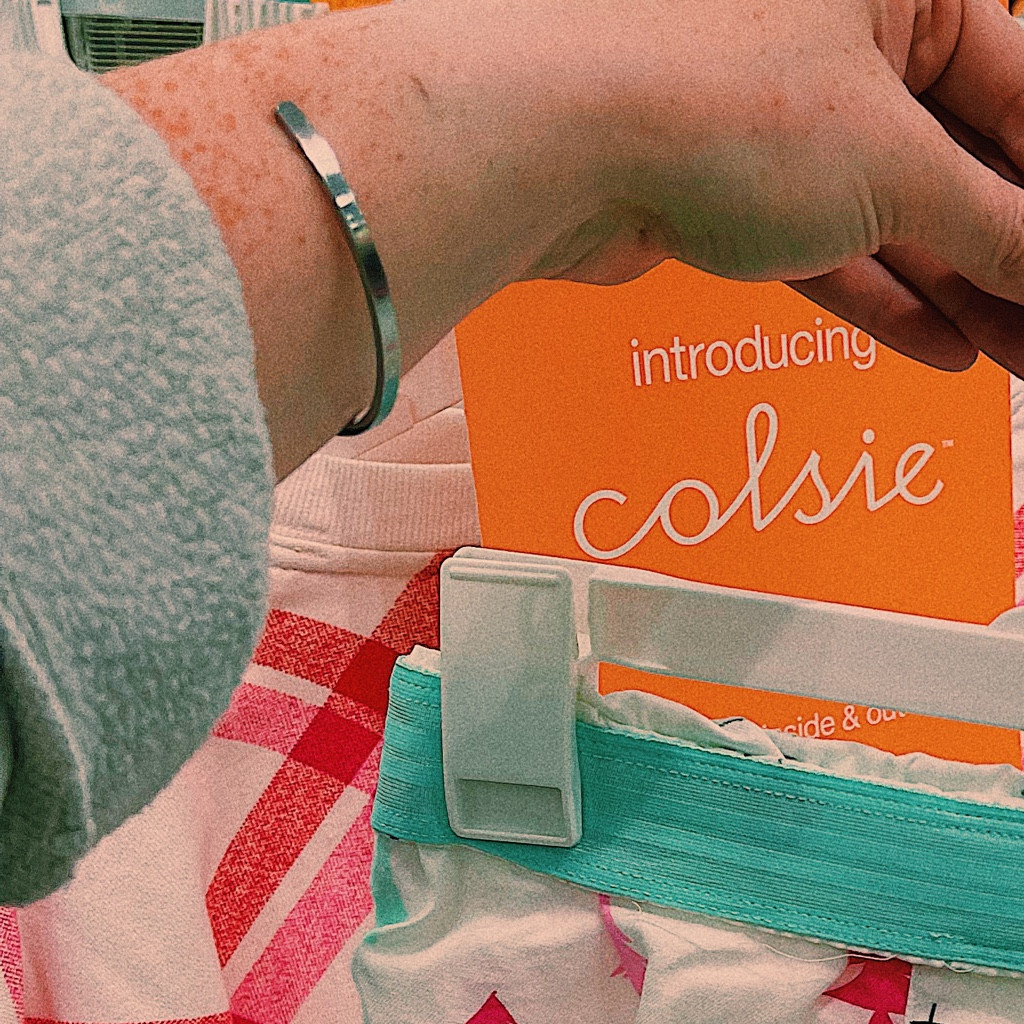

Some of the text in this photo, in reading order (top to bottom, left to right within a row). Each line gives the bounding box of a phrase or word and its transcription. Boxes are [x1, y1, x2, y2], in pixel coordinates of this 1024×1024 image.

[631, 317, 877, 387] introducing
[762, 705, 906, 738] ide & ou
